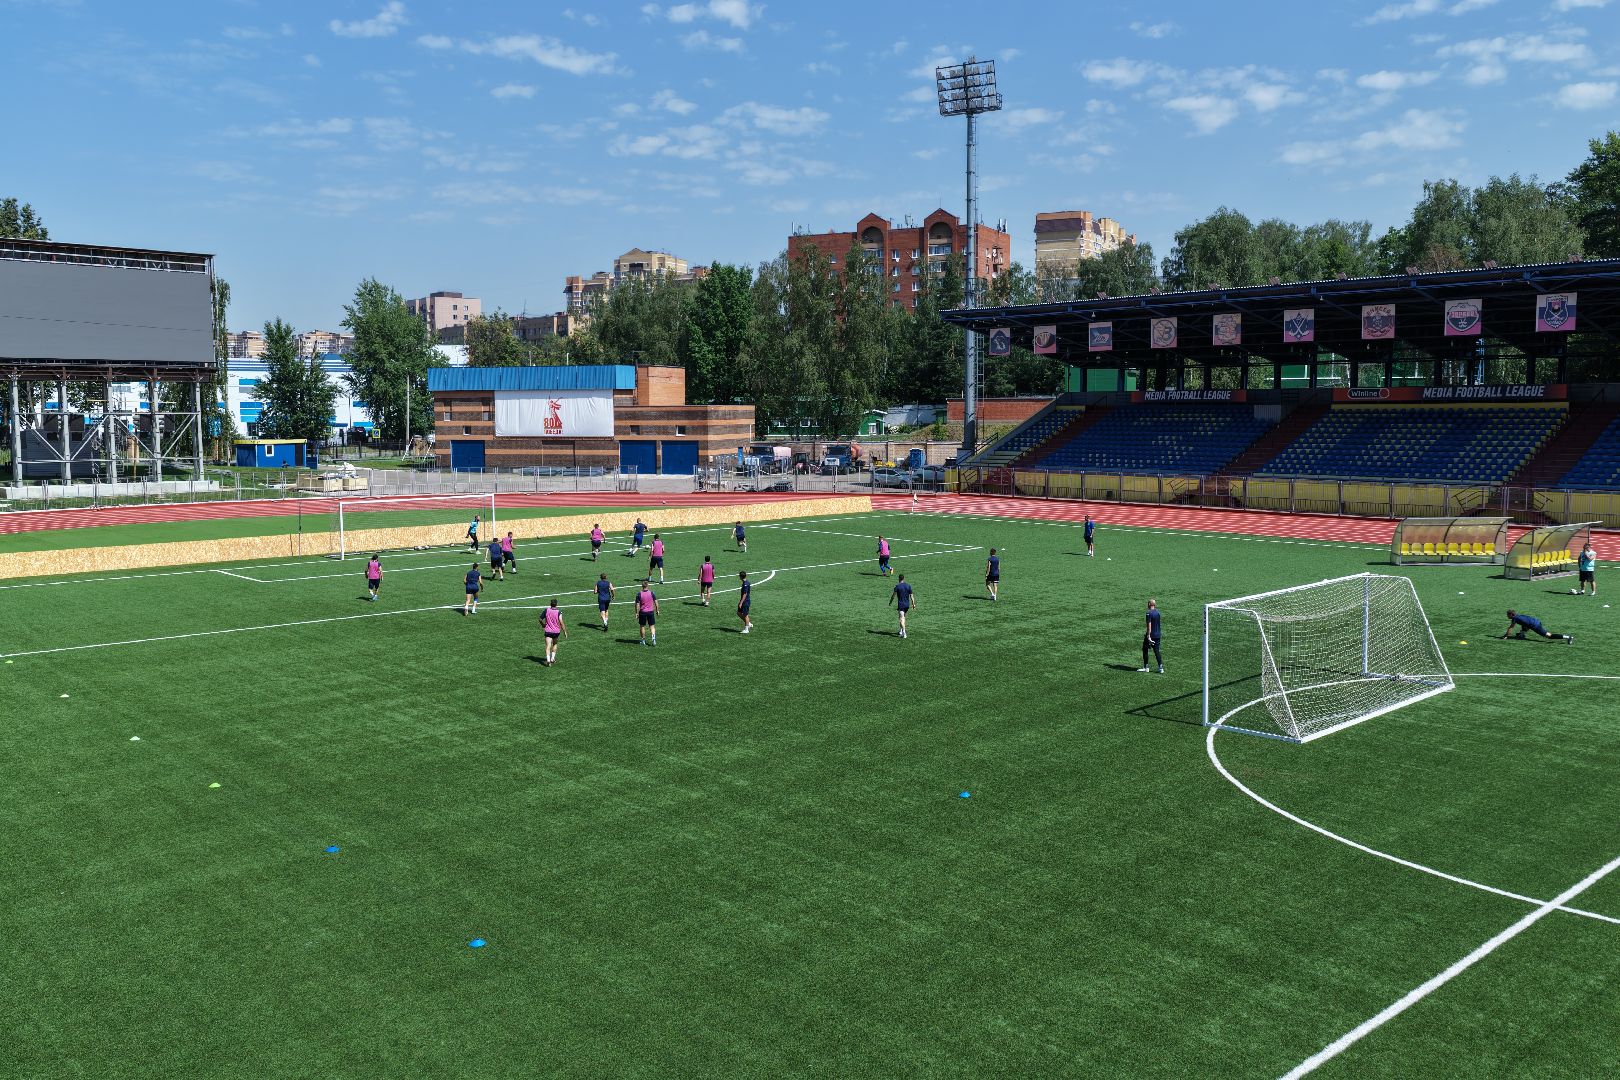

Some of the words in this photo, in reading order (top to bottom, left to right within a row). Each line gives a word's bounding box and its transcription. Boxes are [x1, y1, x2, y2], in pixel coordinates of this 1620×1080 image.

[1144, 391, 1165, 400] MEDIA
[1167, 390, 1202, 400] FOOTBALL
[1203, 390, 1231, 400] LEAGUE
[1423, 387, 1453, 398] MEDIA
[1454, 386, 1503, 398] FOOTBALL
[1505, 385, 1545, 397] LEAGUE
